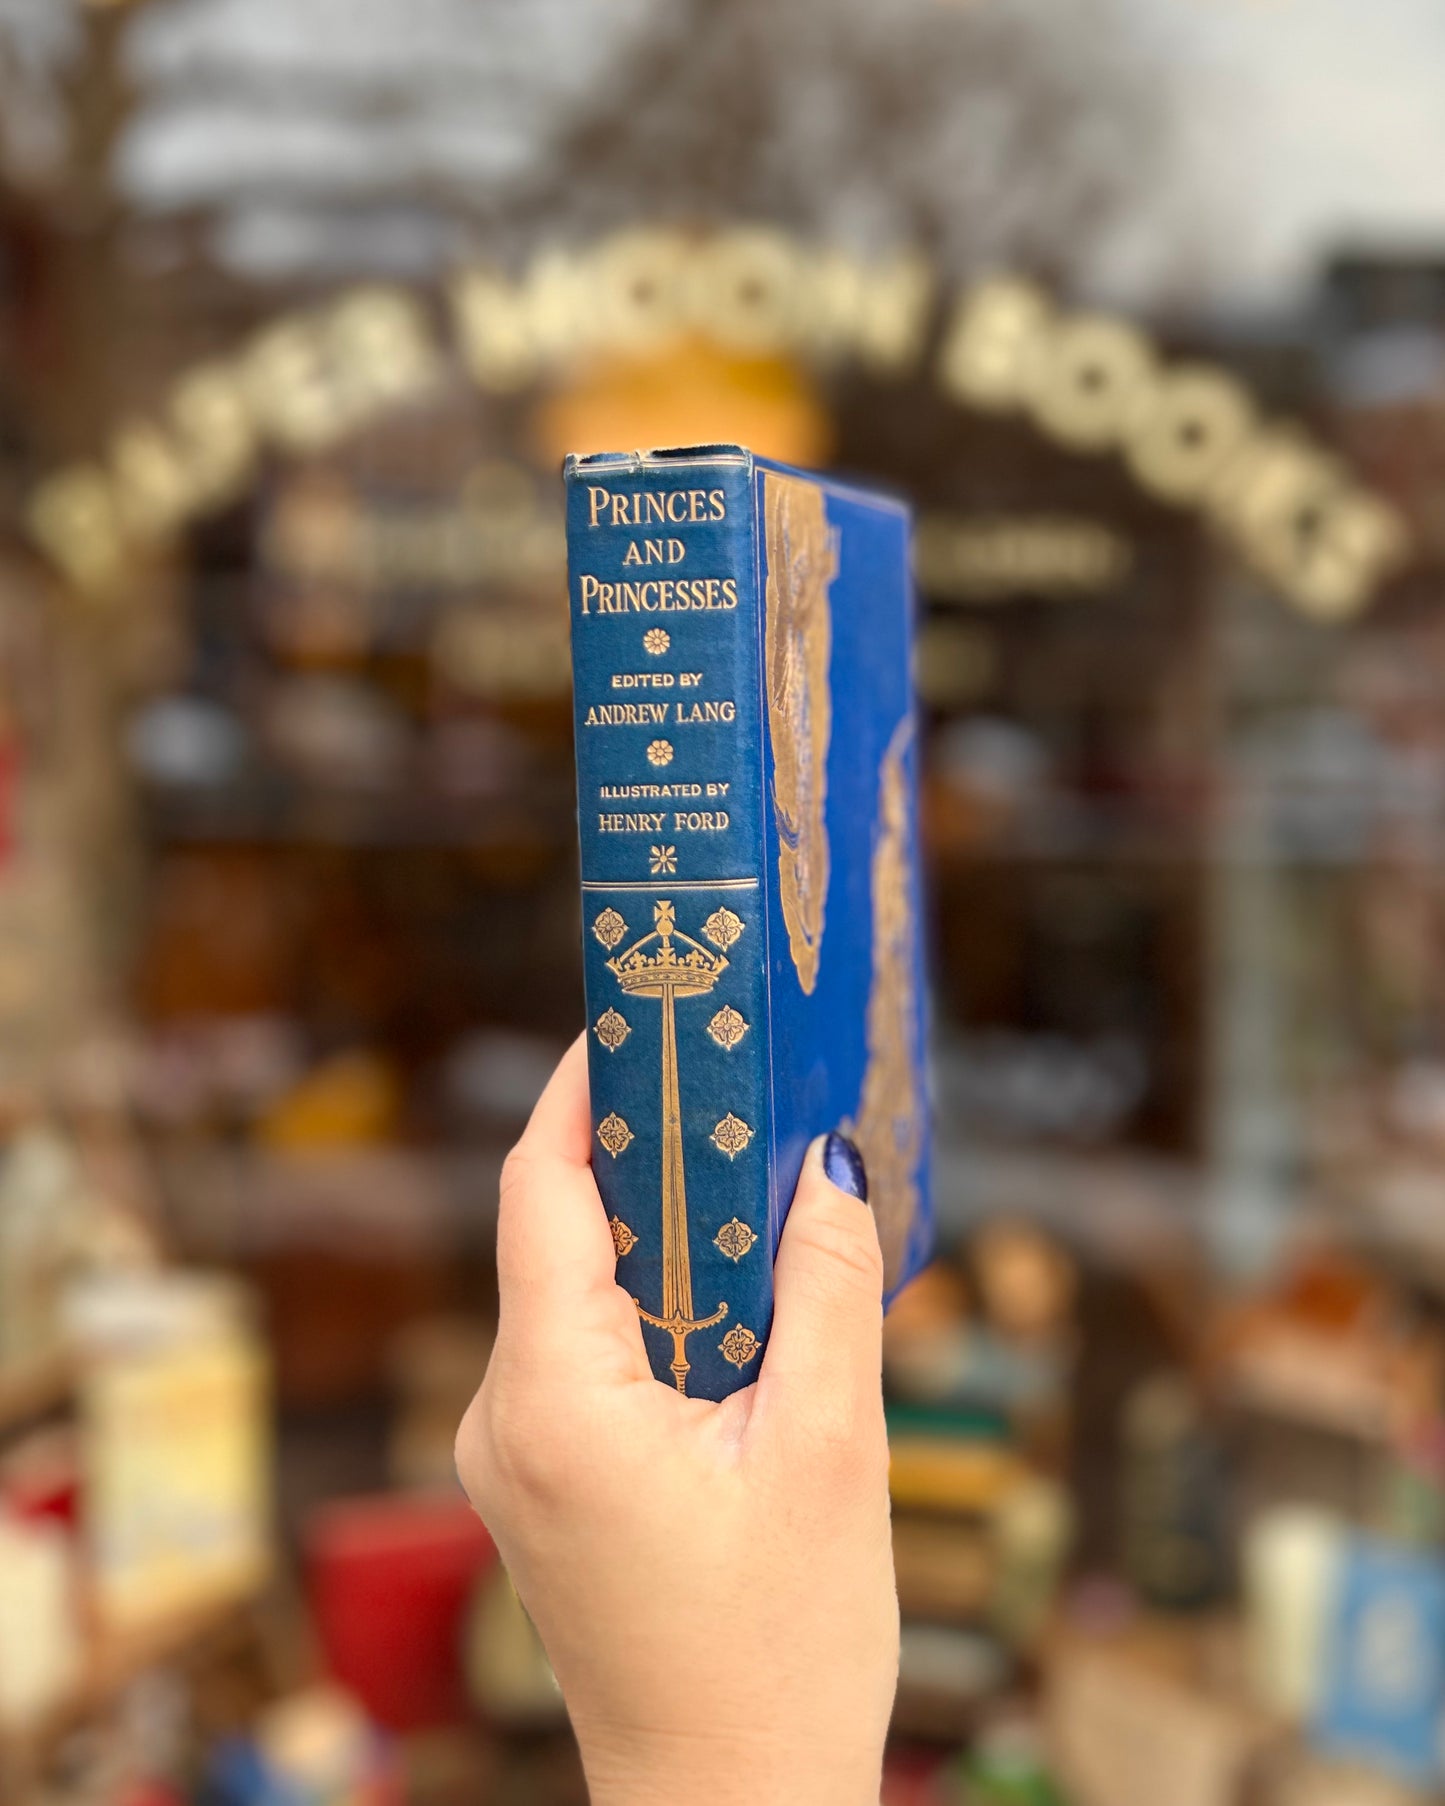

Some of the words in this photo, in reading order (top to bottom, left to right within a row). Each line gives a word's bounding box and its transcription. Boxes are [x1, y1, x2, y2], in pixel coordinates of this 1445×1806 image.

[587, 486, 726, 527] PRINCES
[622, 537, 686, 566] AND
[579, 574, 739, 615] PRINCESSES
[611, 673, 675, 688] EDITED
[679, 672, 704, 687] BY
[584, 702, 670, 726] ANDREW
[675, 701, 736, 724] LANG
[600, 784, 702, 798] ILLUSTRATED
[706, 782, 730, 797] BY
[598, 812, 667, 833] HENRY
[673, 811, 731, 832] FORD
